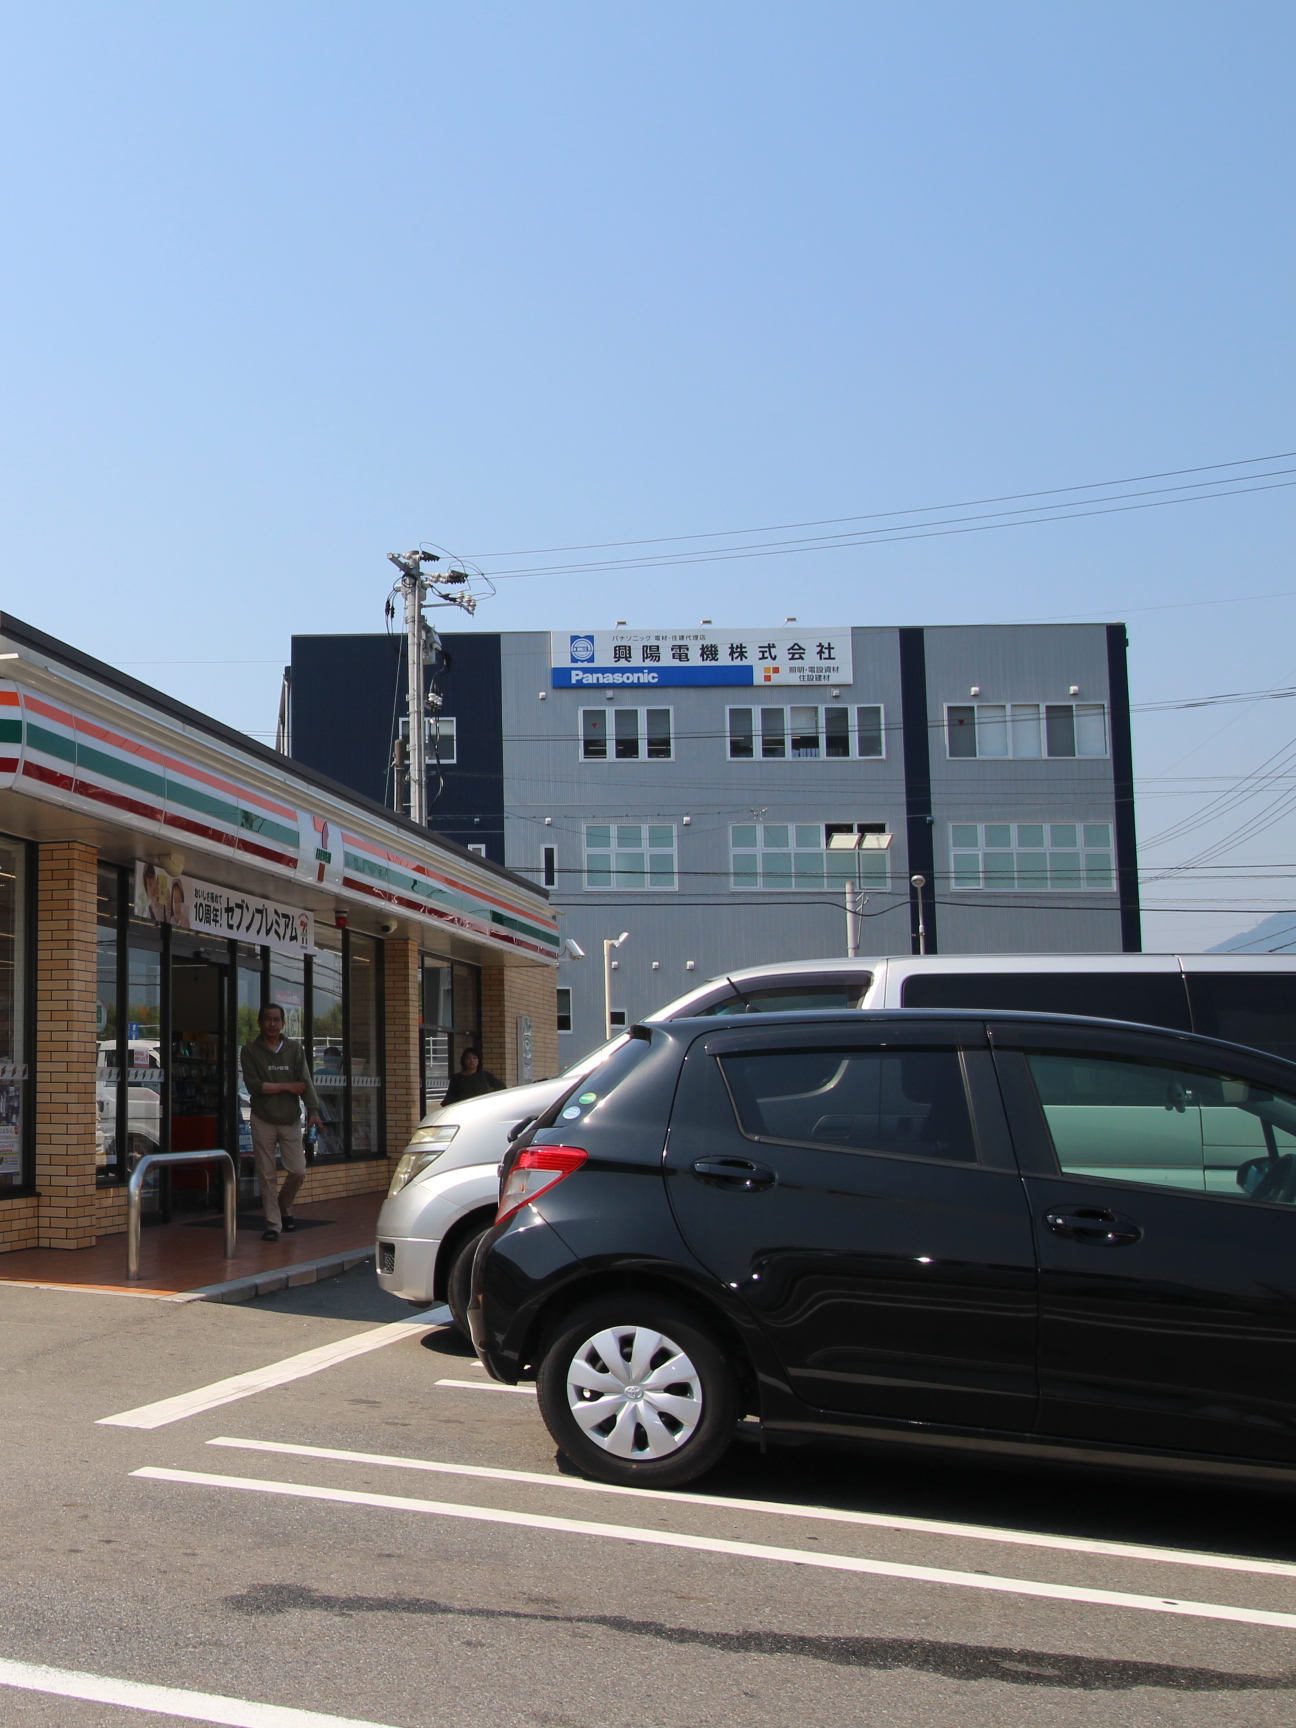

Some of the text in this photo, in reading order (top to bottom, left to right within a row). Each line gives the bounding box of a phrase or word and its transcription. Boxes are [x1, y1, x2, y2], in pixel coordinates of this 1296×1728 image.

[612, 642, 836, 664] 興陽電機株式会社
[570, 669, 659, 685] Panasonic
[224, 897, 298, 943] セブンプレミアム
